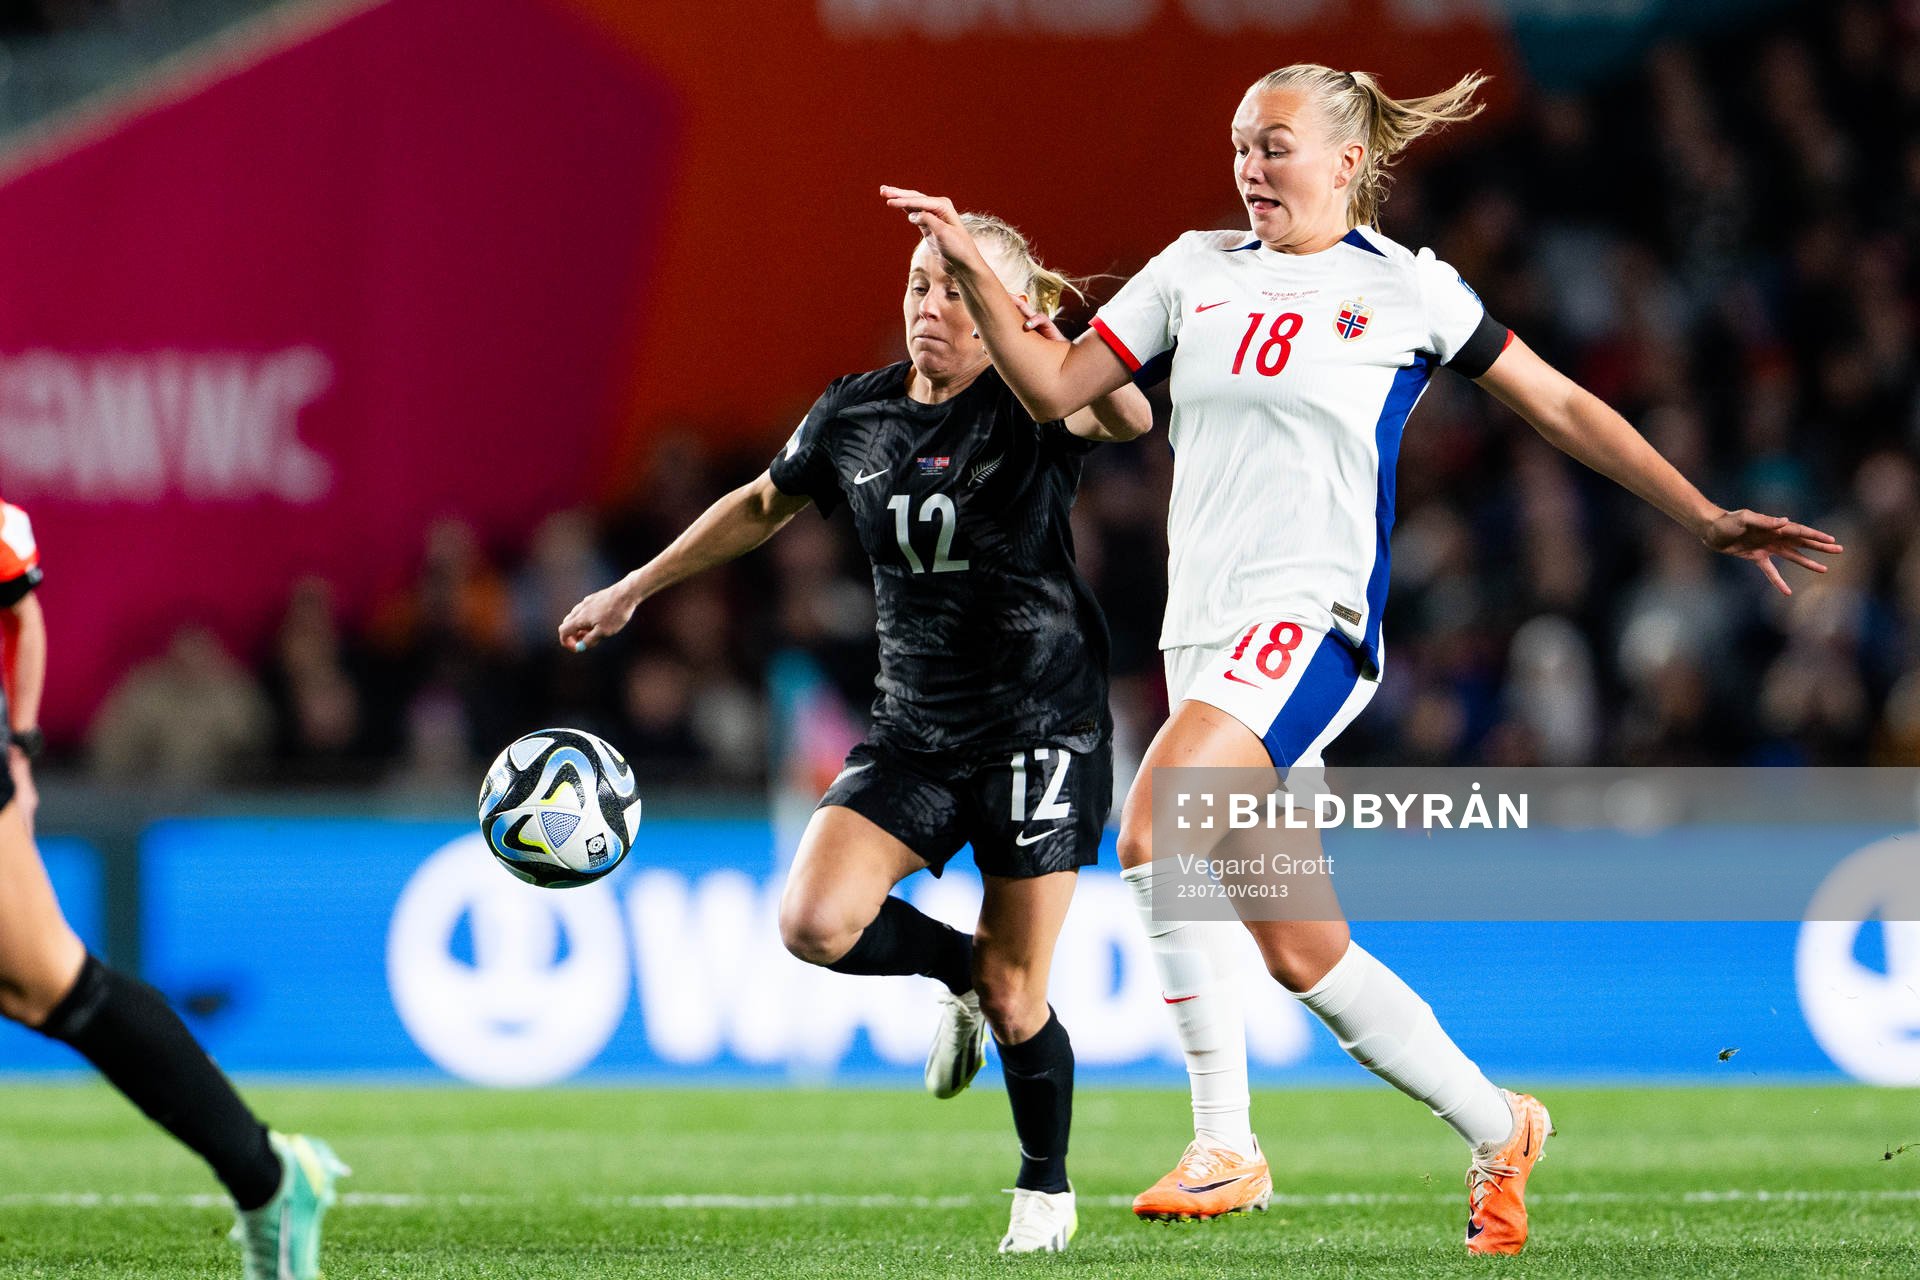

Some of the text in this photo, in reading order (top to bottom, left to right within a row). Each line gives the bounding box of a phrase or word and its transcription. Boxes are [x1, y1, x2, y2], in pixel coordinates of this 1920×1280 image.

[1231, 312, 1304, 377] 18
[886, 493, 970, 575] 12
[1230, 621, 1303, 680] 18
[1010, 748, 1072, 822] 12
